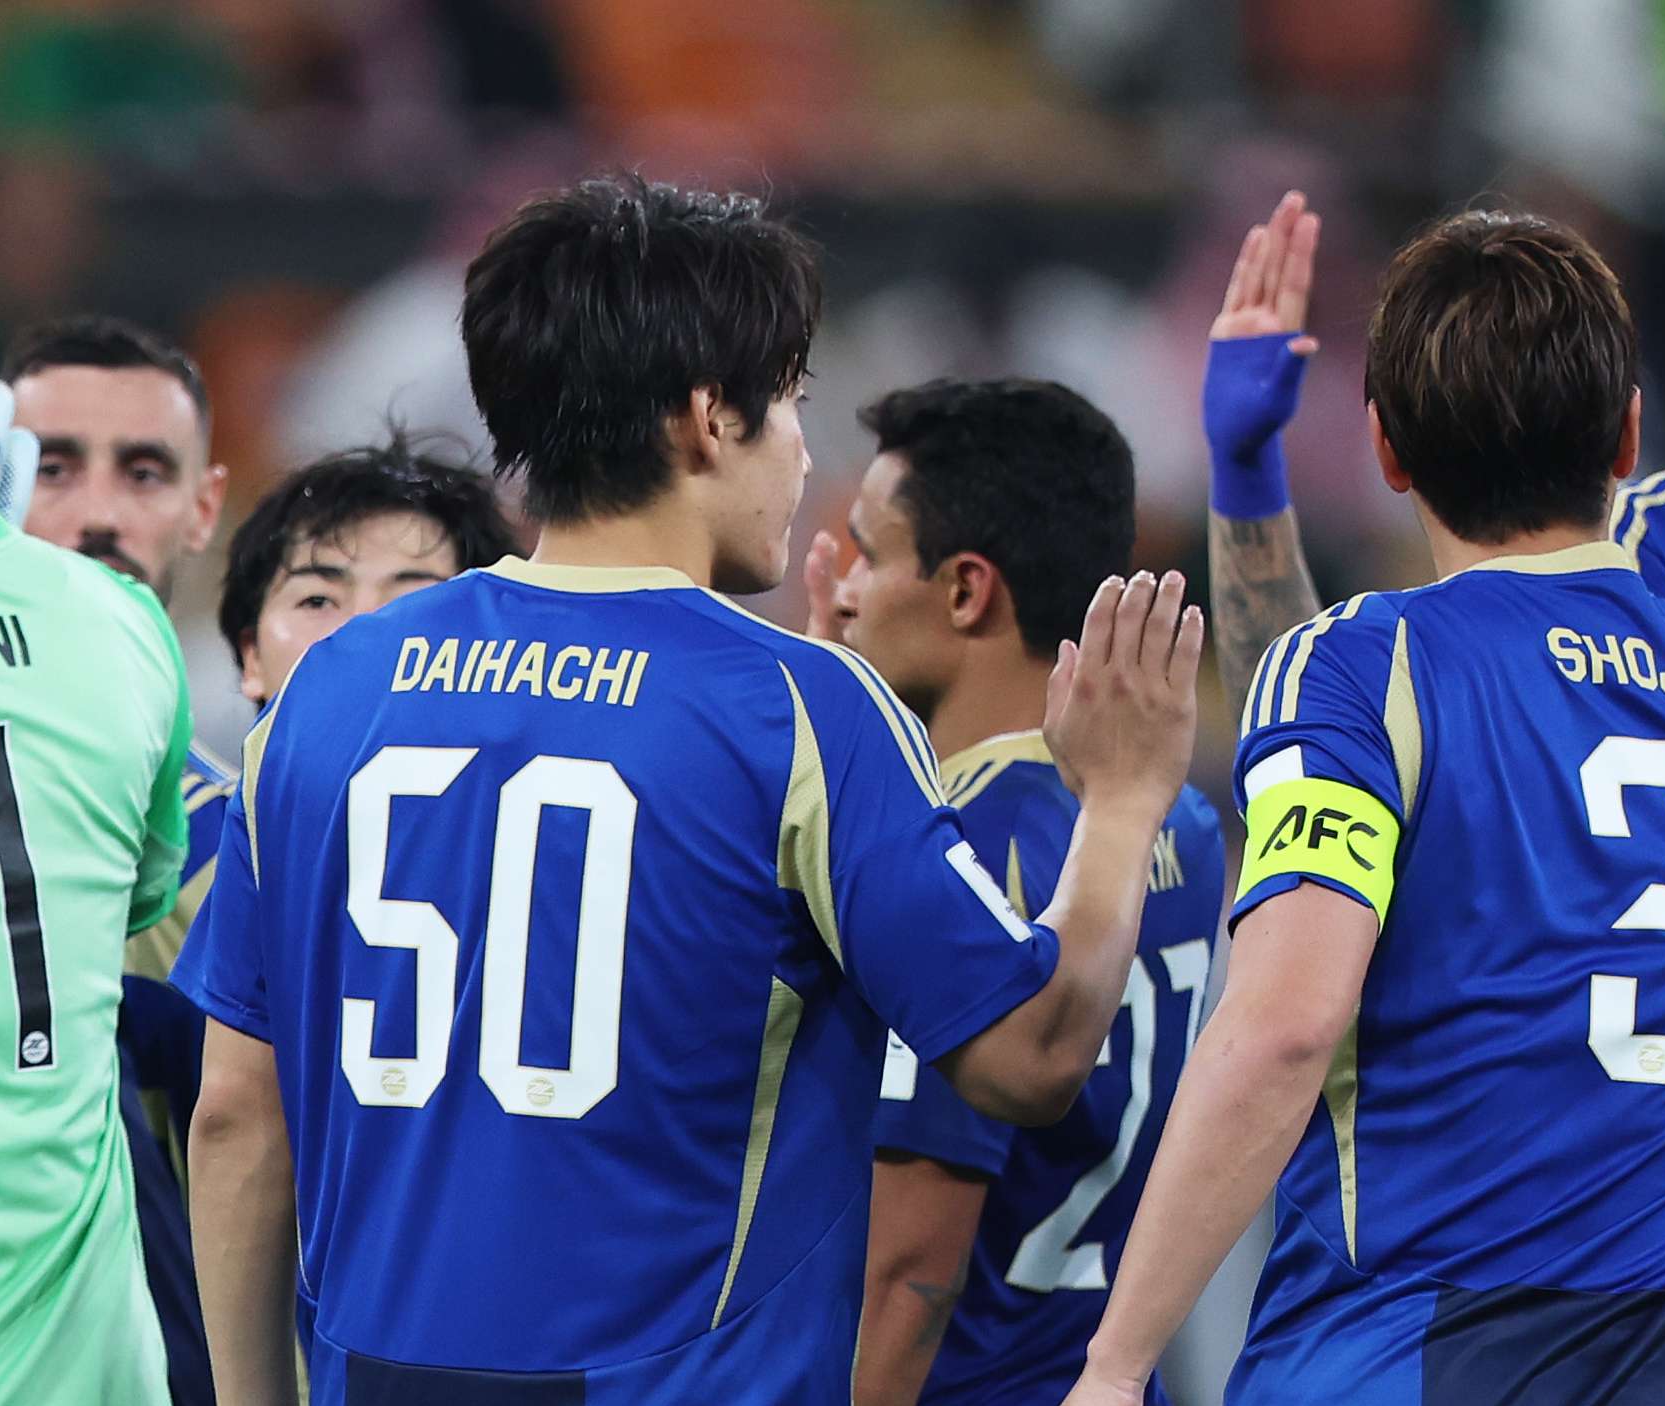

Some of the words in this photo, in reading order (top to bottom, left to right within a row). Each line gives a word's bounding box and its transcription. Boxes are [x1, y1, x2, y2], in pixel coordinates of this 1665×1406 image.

[390, 635, 650, 708] DAIHACHI
[1258, 804, 1380, 871] AFC
[340, 745, 639, 1120] 50
